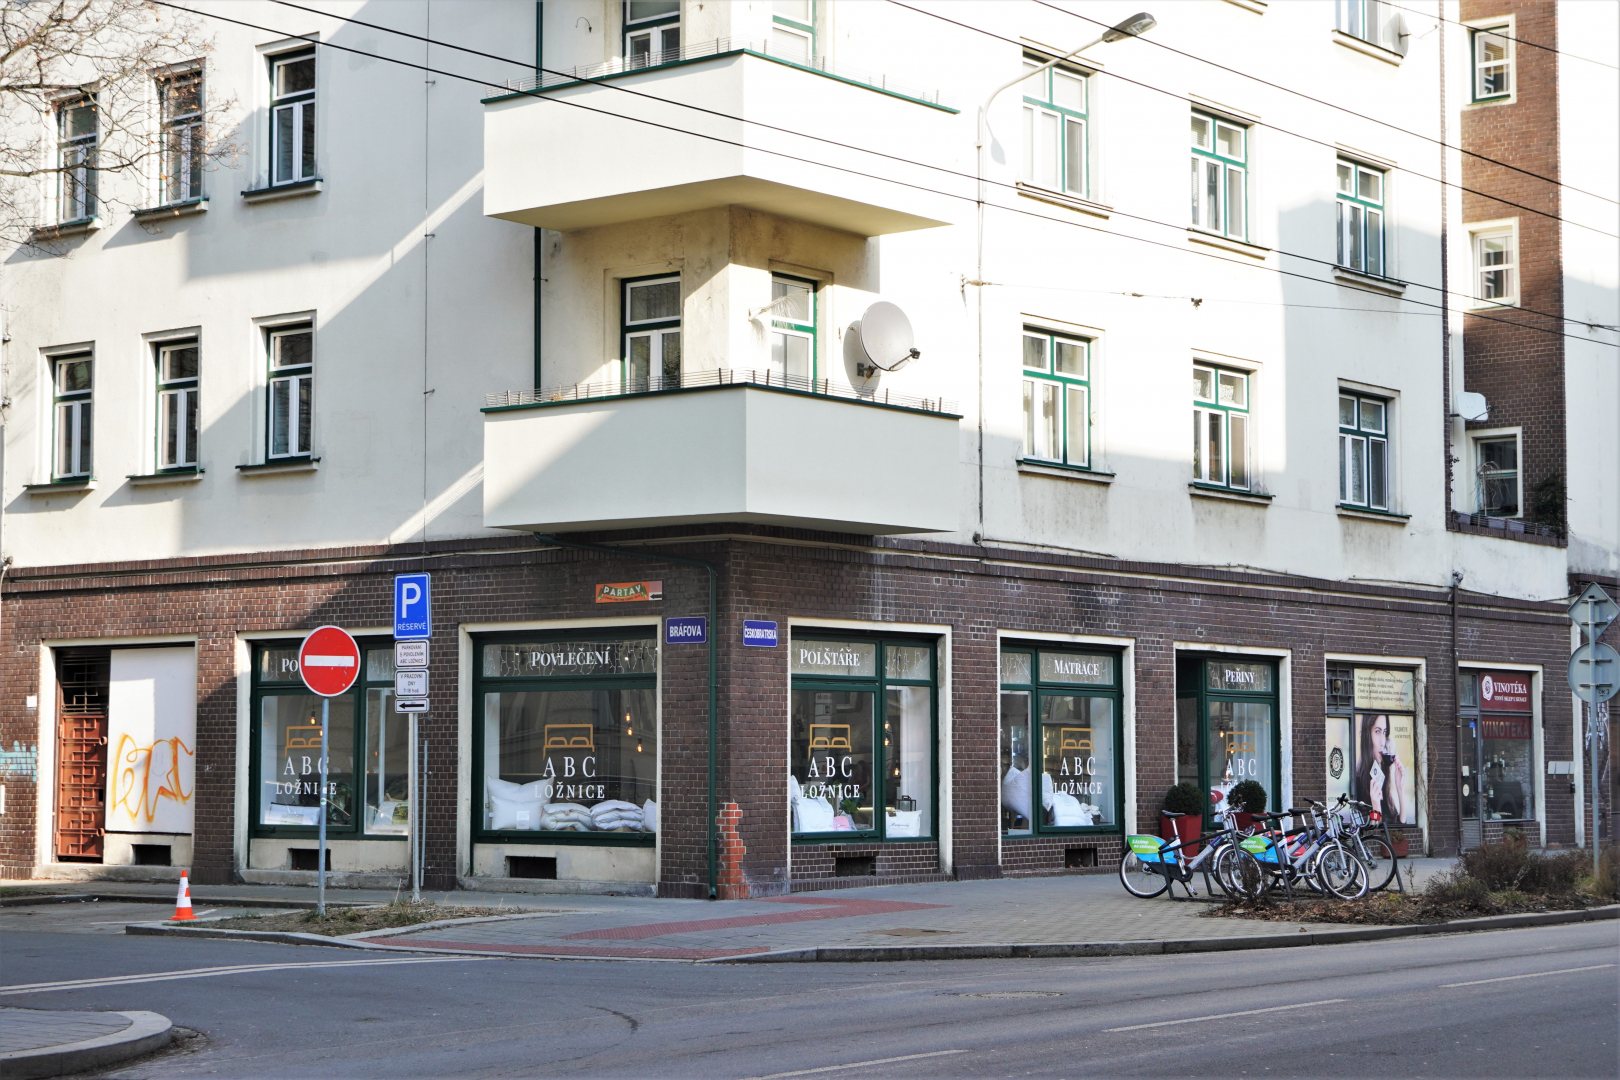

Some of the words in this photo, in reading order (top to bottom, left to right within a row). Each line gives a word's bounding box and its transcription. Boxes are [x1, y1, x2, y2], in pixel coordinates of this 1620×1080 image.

[603, 584, 641, 597] PARTAY
[402, 582, 421, 619] P
[397, 621, 427, 631] RÉSERVÉ
[669, 623, 702, 637] BRÁFOVA
[744, 625, 777, 640] ČESKOBRATRSKÁ
[531, 646, 611, 667] POVLEČENÍ
[799, 647, 860, 666] POLŠTÁŘE
[1054, 659, 1100, 676] MATRACE
[1225, 667, 1255, 683] PEŘINY
[1493, 681, 1527, 694] VINOTÉKA
[1482, 719, 1530, 737] VINOTÉKA
[543, 756, 596, 778] ABC
[808, 756, 853, 778] ABC
[1060, 756, 1096, 776] ABC
[1225, 758, 1257, 776] ABC
[276, 779, 337, 795] LOŽNIE
[534, 781, 605, 799] LOŽNICE
[800, 782, 860, 799] LOŽNICE
[1053, 779, 1103, 795] LOŽNICE
